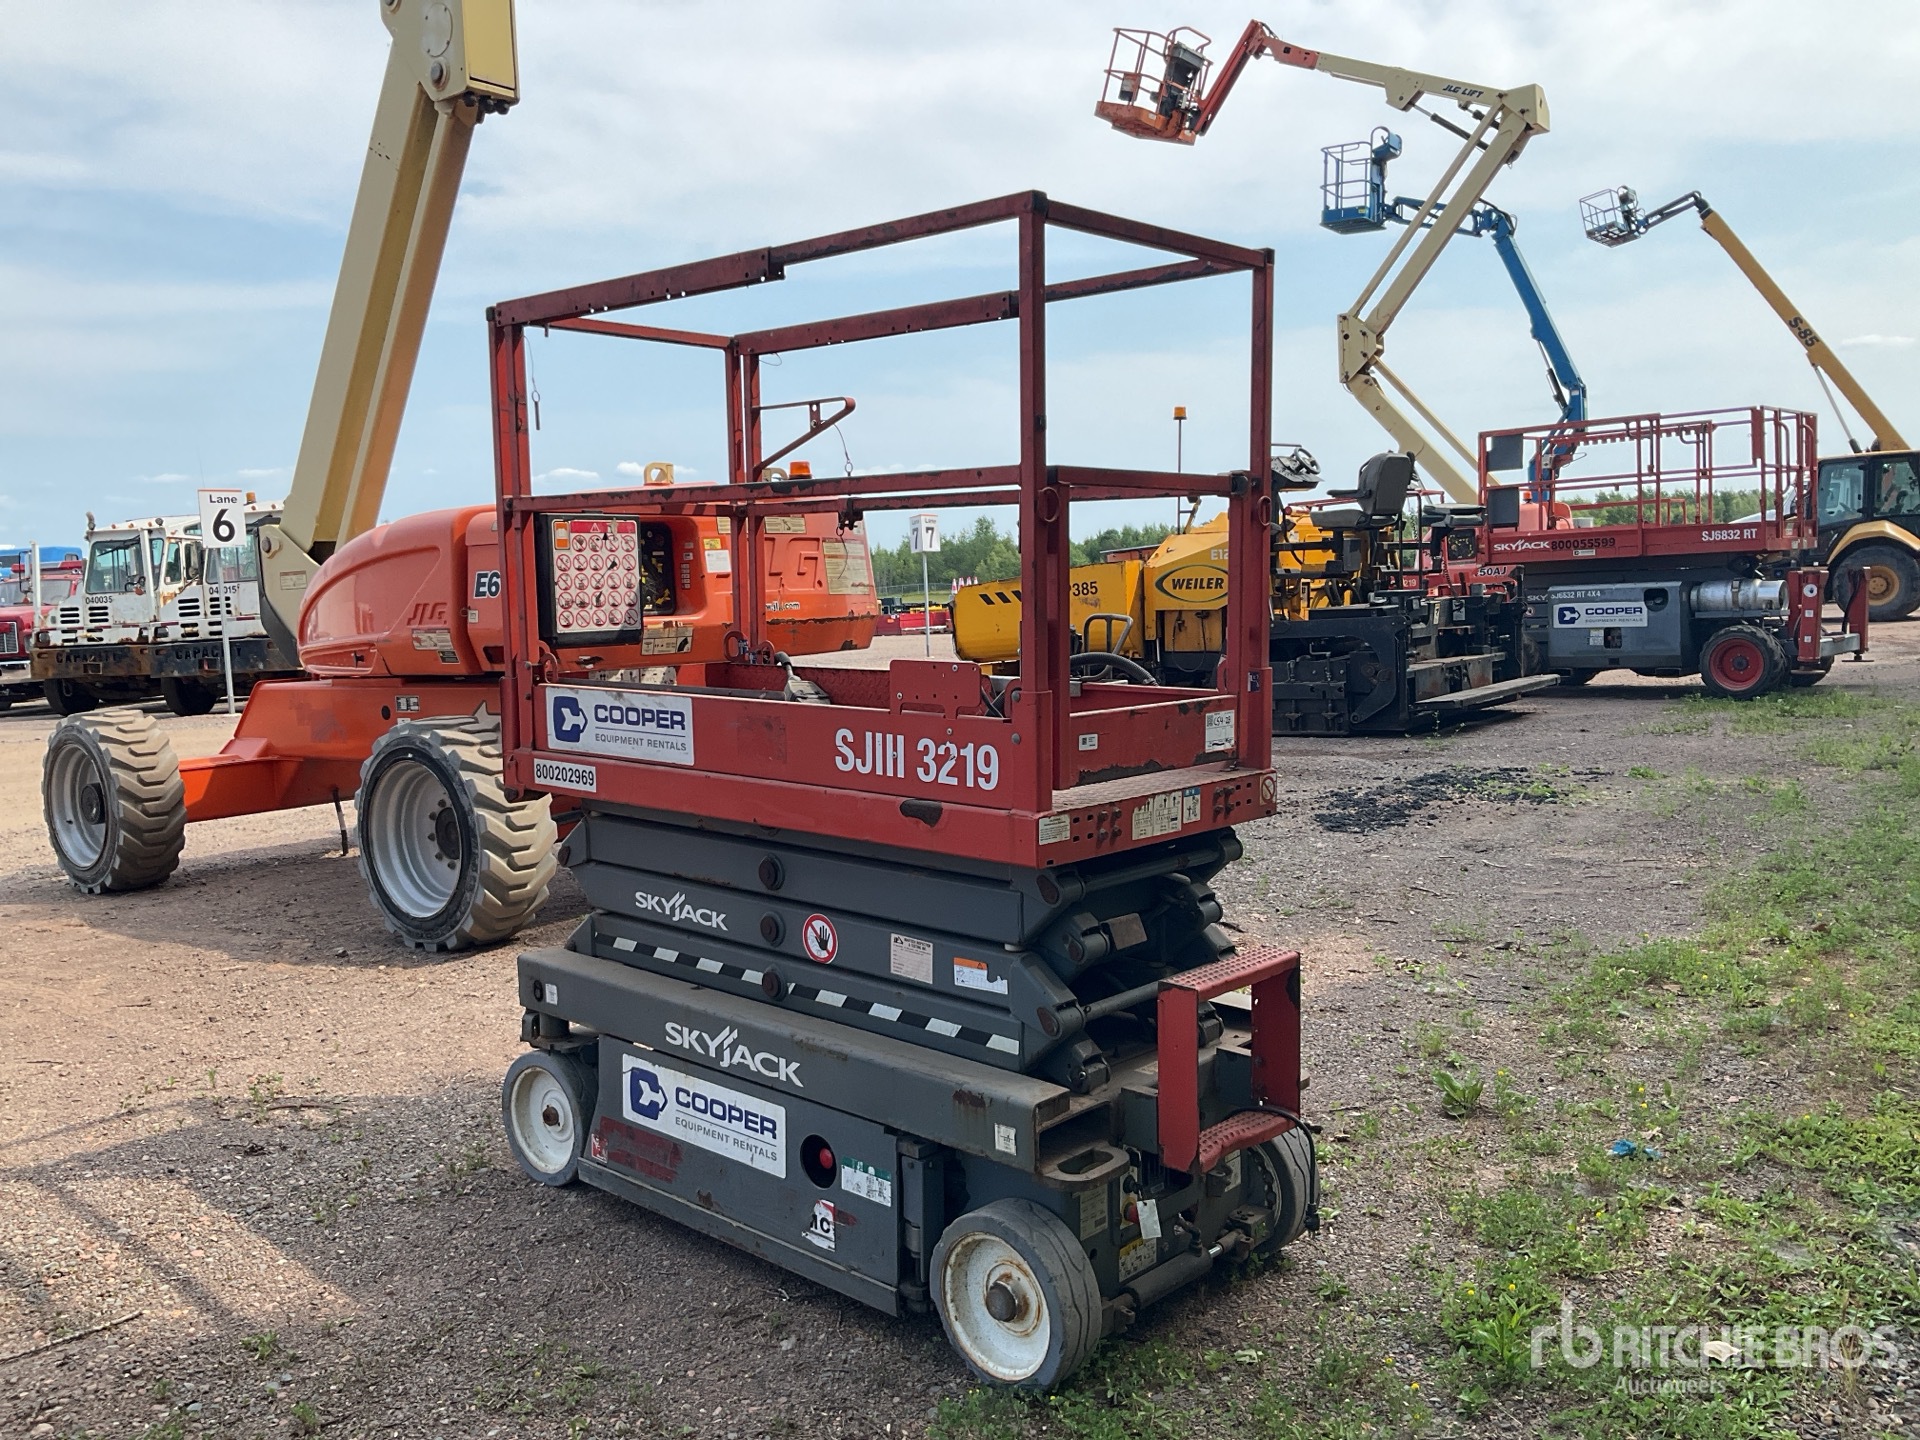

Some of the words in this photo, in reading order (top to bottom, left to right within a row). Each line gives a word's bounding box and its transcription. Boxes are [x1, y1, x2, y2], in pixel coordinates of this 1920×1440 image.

[1442, 84, 1462, 93] JLG
[1462, 88, 1484, 98] LIFT
[1789, 316, 1820, 347] S-85
[209, 494, 237, 504] Lane
[213, 508, 235, 542] 6
[1701, 529, 1740, 541] SJ6832
[1743, 528, 1757, 539] RT
[912, 527, 919, 549] 7
[925, 526, 935, 548] 7
[1493, 539, 1551, 551] SKYJACK
[1551, 538, 1616, 550] 800055599
[1171, 577, 1225, 590] WEILER
[85, 596, 113, 605] 040035
[1586, 607, 1643, 616] COOPER
[594, 704, 686, 730] COOPER
[595, 733, 643, 747] EQUIPMENT
[647, 739, 687, 752] RENTALS
[535, 763, 595, 786] 800202969
[916, 737, 999, 790] 3219
[635, 890, 728, 932] SKYJACK
[664, 1021, 804, 1088] SKYJACK
[675, 1086, 777, 1140] COOPER
[674, 1116, 731, 1146] EQUIPMENT
[732, 1137, 778, 1161] RENTALS
